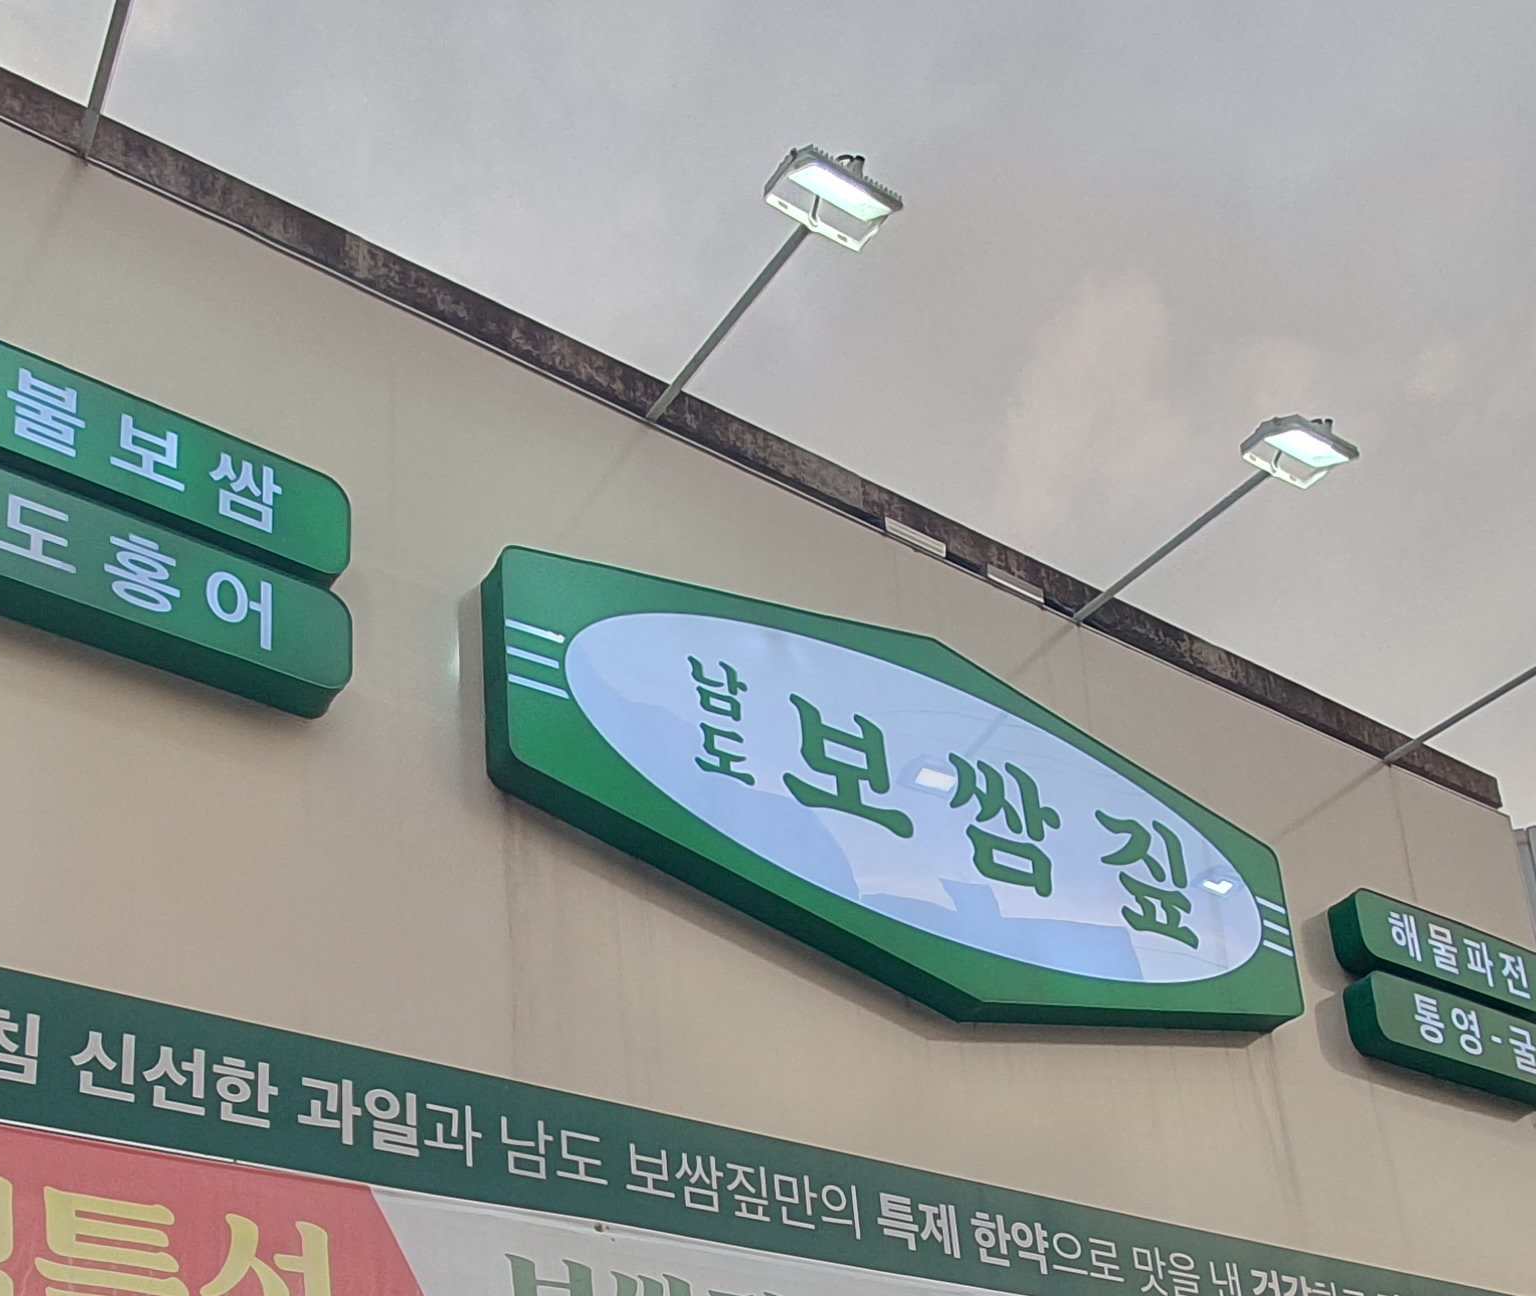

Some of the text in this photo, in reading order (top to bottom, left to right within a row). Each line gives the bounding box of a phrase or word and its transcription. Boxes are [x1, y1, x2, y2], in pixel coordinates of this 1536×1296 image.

[782, 691, 1201, 951] 보쌈짚
[1387, 910, 1531, 1000] 해물파전
[70, 1027, 280, 1131] 신선한
[297, 1073, 482, 1168] 과일과
[498, 1115, 609, 1187] 남도
[625, 1141, 863, 1241] 보쌈짚만의
[875, 1191, 962, 1260] 특제
[969, 1210, 1125, 1286] 한약으로
